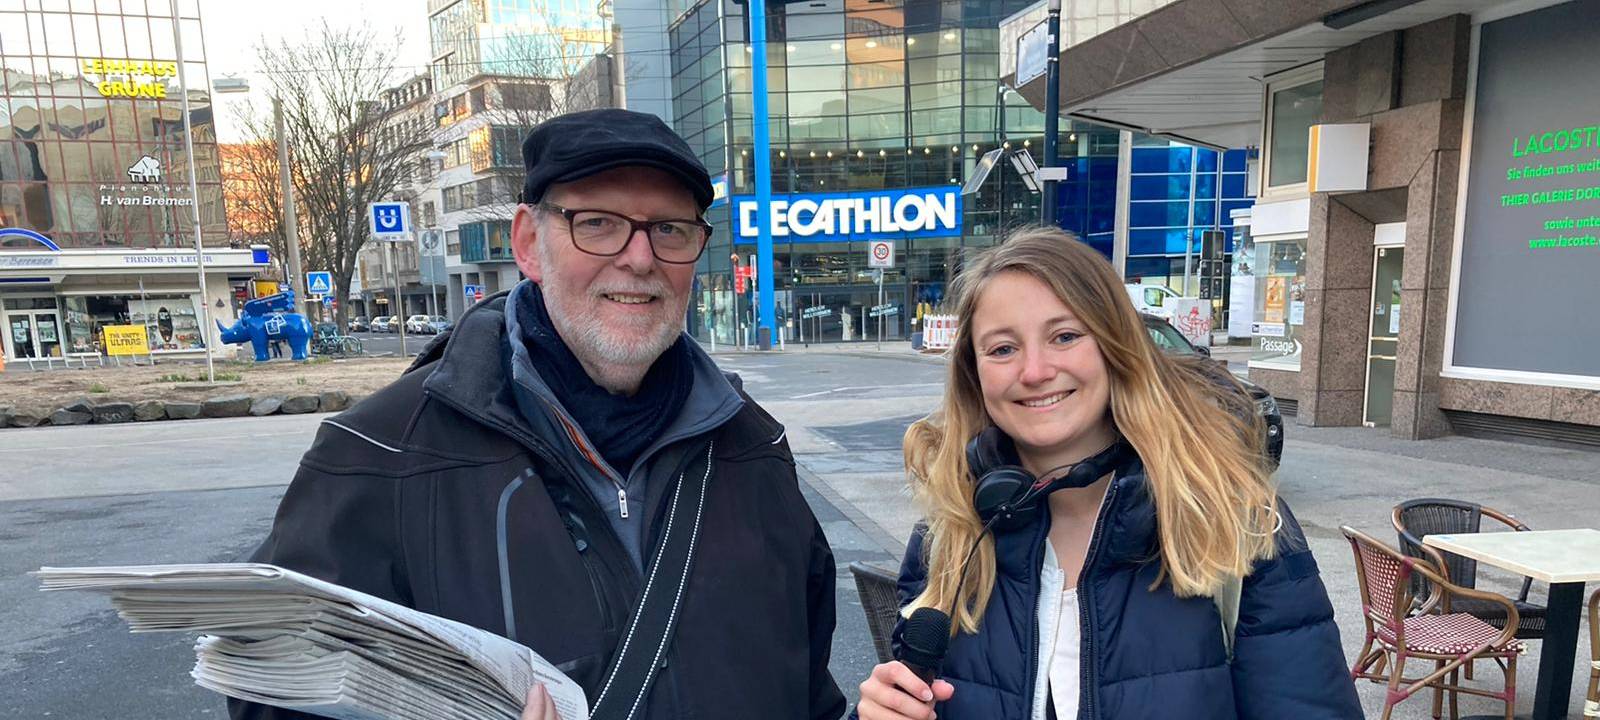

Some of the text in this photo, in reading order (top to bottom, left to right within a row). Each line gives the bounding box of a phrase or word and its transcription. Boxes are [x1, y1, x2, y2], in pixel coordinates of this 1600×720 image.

[82, 58, 177, 77] LEIHHAUS
[98, 80, 167, 98] GRÜNE
[1513, 126, 1600, 158] LACOST
[1507, 167, 1521, 180] Sie
[1523, 165, 1554, 178] finden
[1557, 163, 1574, 175] uns
[116, 198, 140, 206] van
[142, 195, 193, 206] Bremen
[1501, 193, 1529, 206] THIER
[1531, 189, 1574, 204] GALERIE
[739, 192, 956, 237] DECATHLON
[1544, 216, 1574, 230] sowie
[1528, 234, 1600, 249] www.lacoste.
[877, 247, 886, 256] 30
[1260, 336, 1294, 356] Passage
